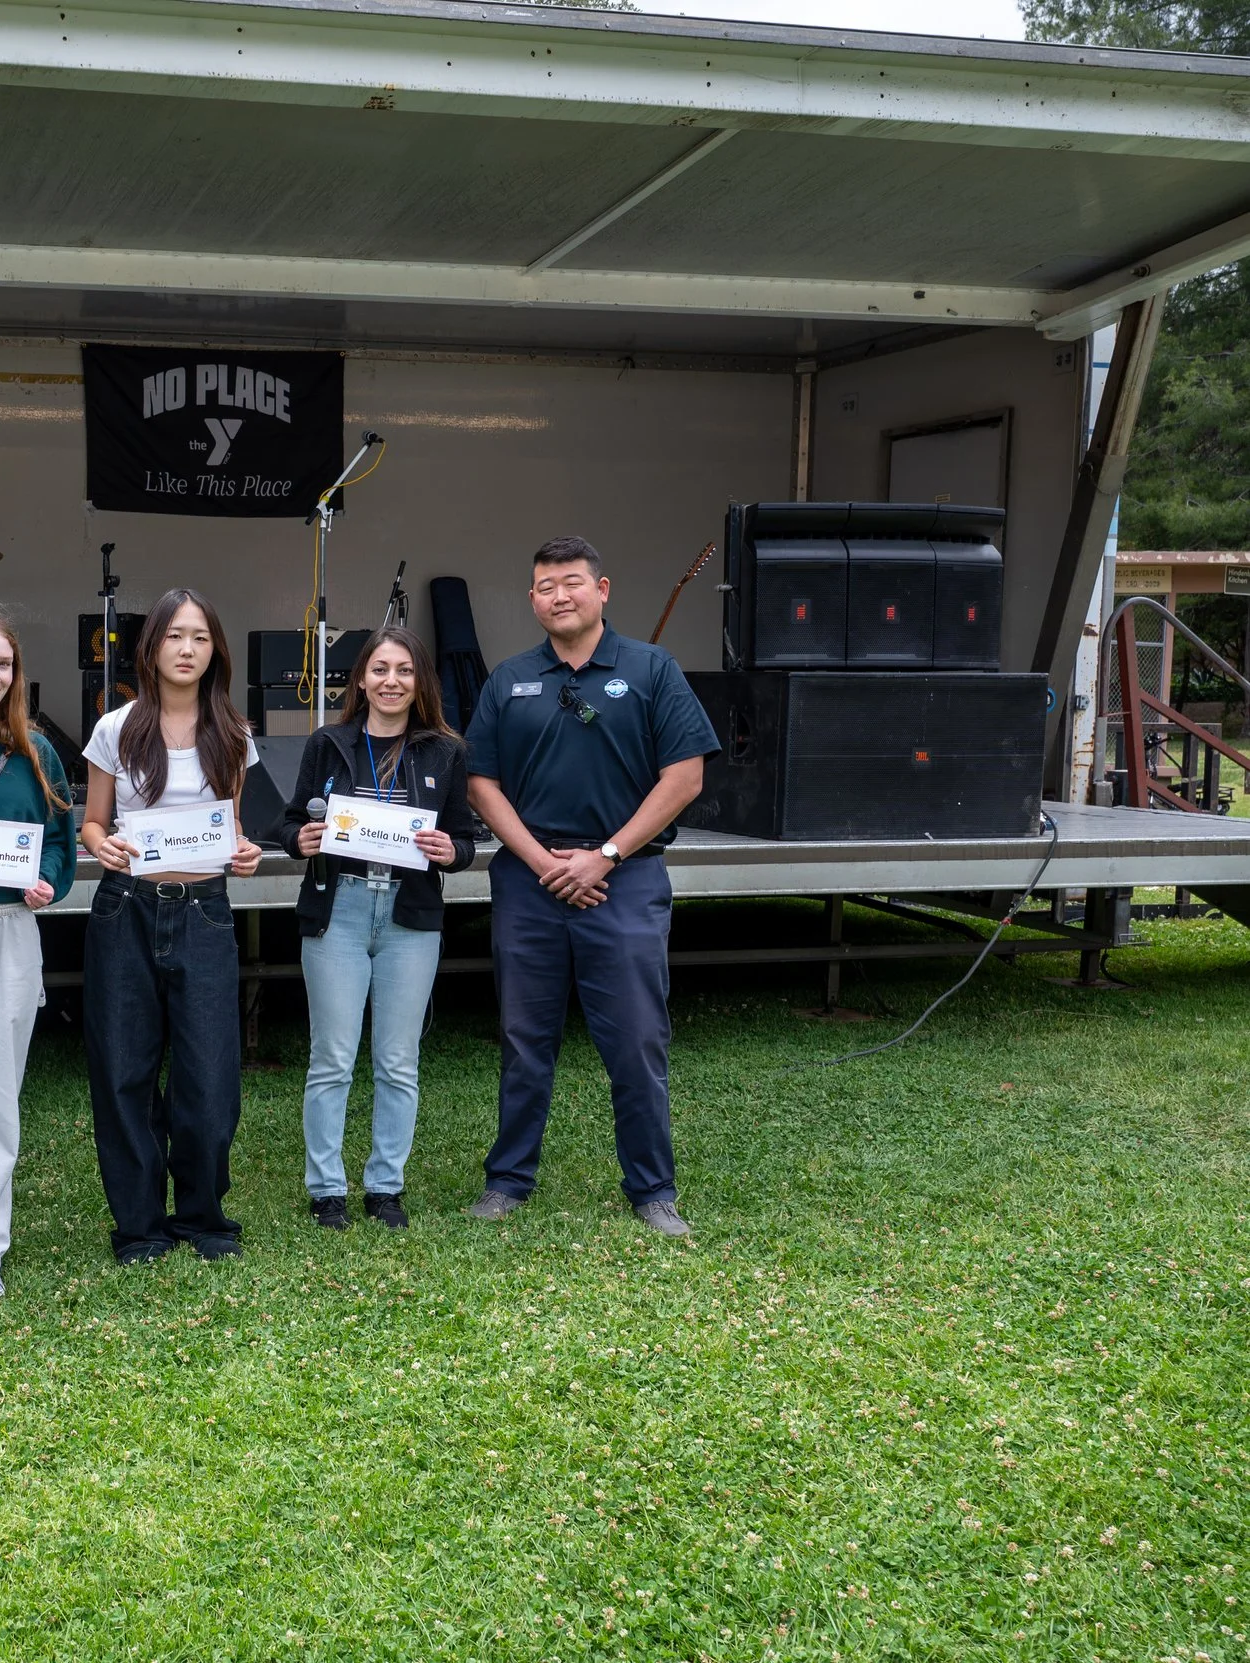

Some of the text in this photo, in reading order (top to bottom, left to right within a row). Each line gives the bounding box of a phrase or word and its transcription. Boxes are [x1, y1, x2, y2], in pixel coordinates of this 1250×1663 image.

[143, 364, 291, 424] NO PLACE
[189, 440, 207, 451] the
[145, 470, 292, 497] Like This Place
[1227, 576, 1248, 585] Kitchen
[164, 832, 222, 847] Minseo Cho
[360, 827, 389, 840] Stella
[392, 832, 410, 844] Um
